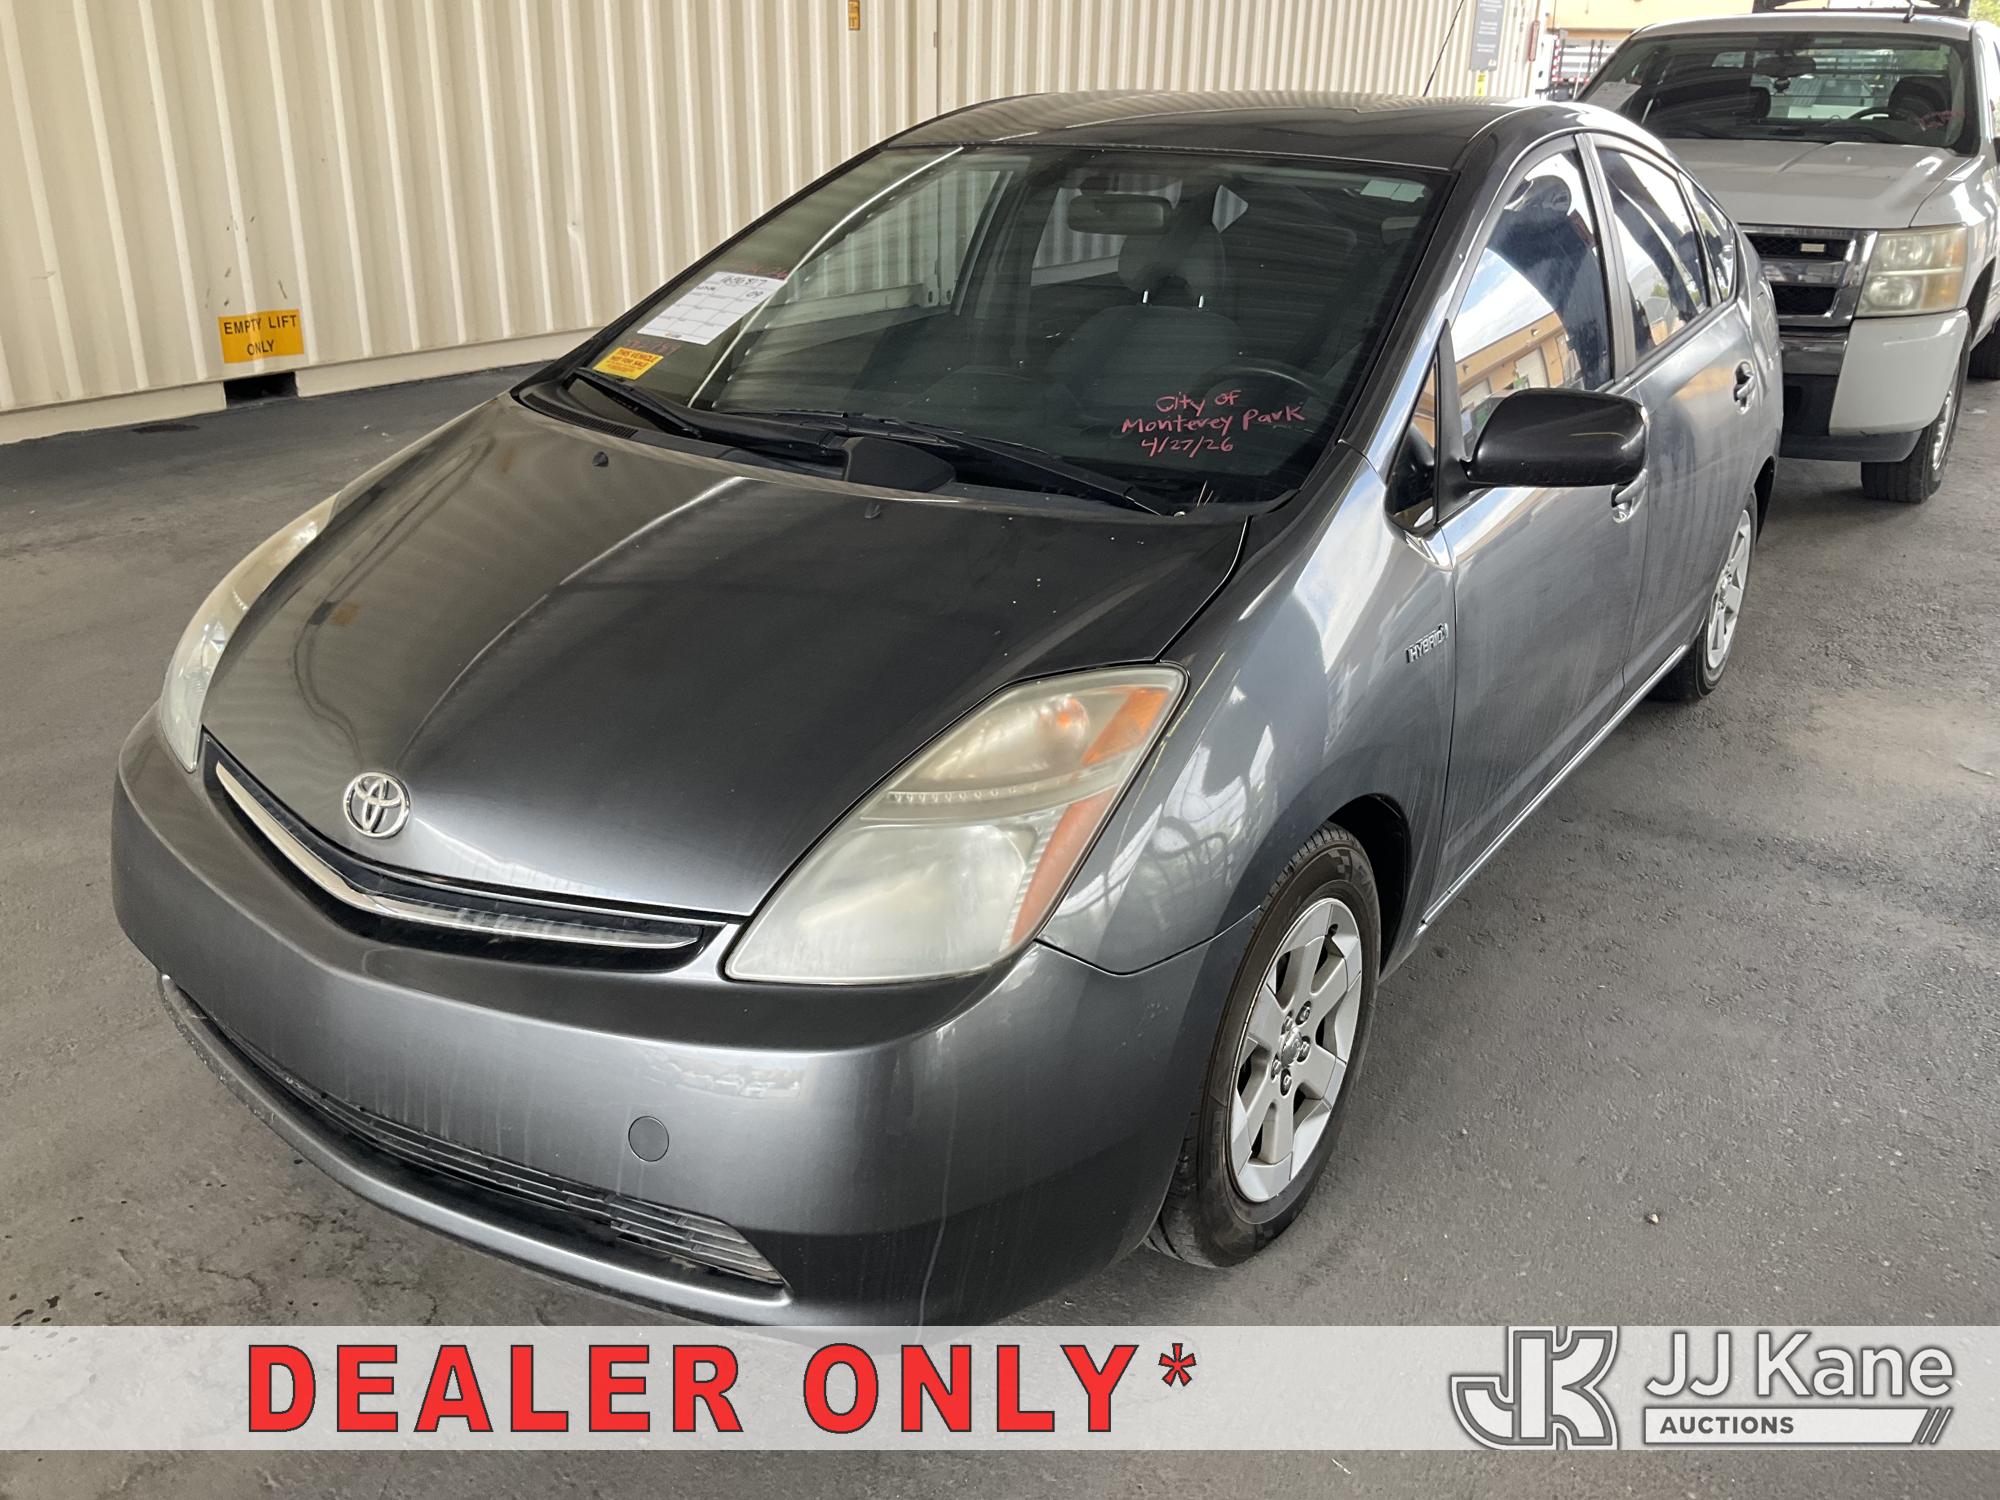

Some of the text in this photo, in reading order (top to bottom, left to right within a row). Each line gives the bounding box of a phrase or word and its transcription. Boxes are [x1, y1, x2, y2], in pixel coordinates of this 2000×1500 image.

[223, 315, 297, 335] EMPTY LIFT
[247, 340, 275, 356] ONLY
[1155, 391, 1205, 417] City
[1121, 415, 1234, 437] Monterey
[1141, 436, 1234, 458] 4/27/26
[1406, 627, 1446, 663] HYBRID
